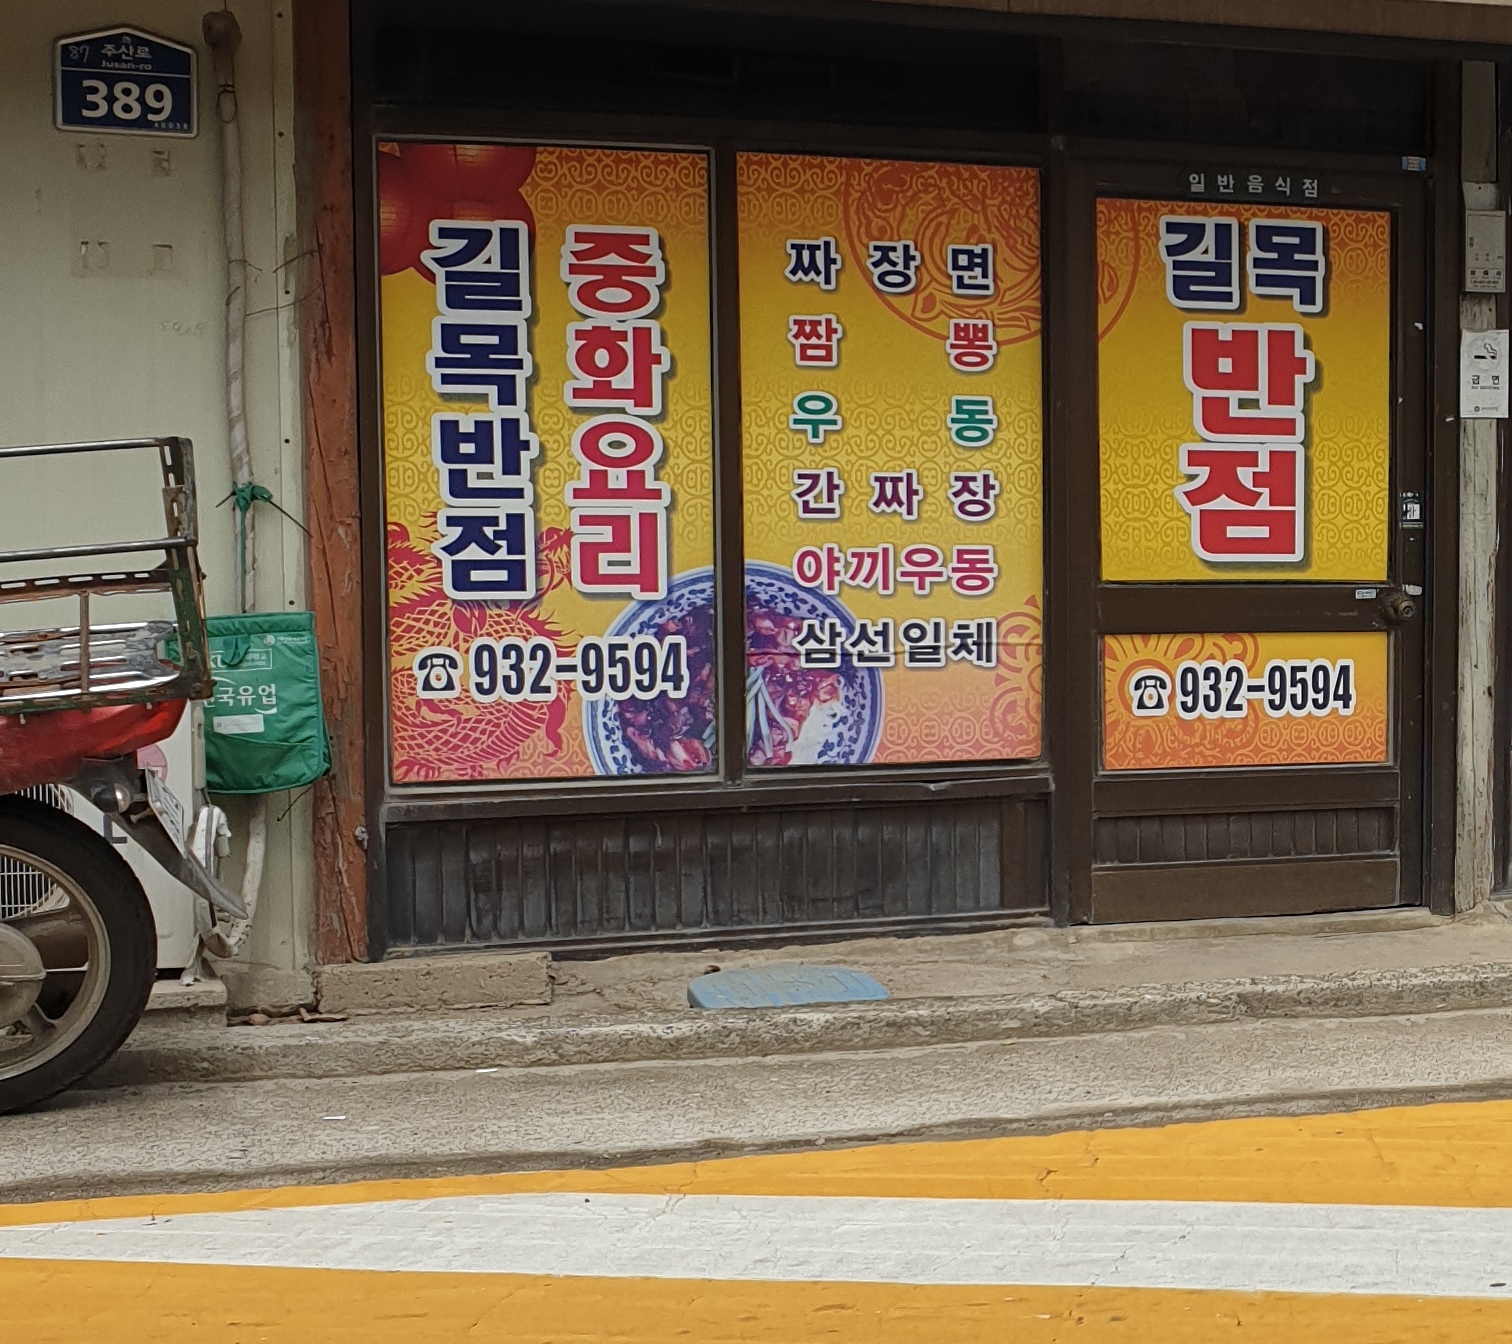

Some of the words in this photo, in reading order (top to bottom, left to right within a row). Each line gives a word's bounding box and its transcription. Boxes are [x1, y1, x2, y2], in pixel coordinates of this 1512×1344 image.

[101, 44, 152, 60] 주산로
[101, 59, 152, 70] Jusan-ro
[81, 79, 173, 122] 389
[1189, 173, 1319, 197] 일반음식점
[786, 239, 992, 292] 짜장면
[1162, 217, 1324, 311] 길목
[790, 316, 995, 370] 짬뽕
[424, 224, 534, 596] 길목반점
[566, 229, 664, 596] 중화요리
[791, 393, 996, 446] 우동
[1182, 324, 1312, 560] 반점
[793, 470, 996, 522] 간짜장
[795, 546, 998, 594] 야끼우동
[473, 640, 688, 698] 932-9594
[795, 620, 998, 667] 삼선일체
[1179, 662, 1354, 715] 932-9594
